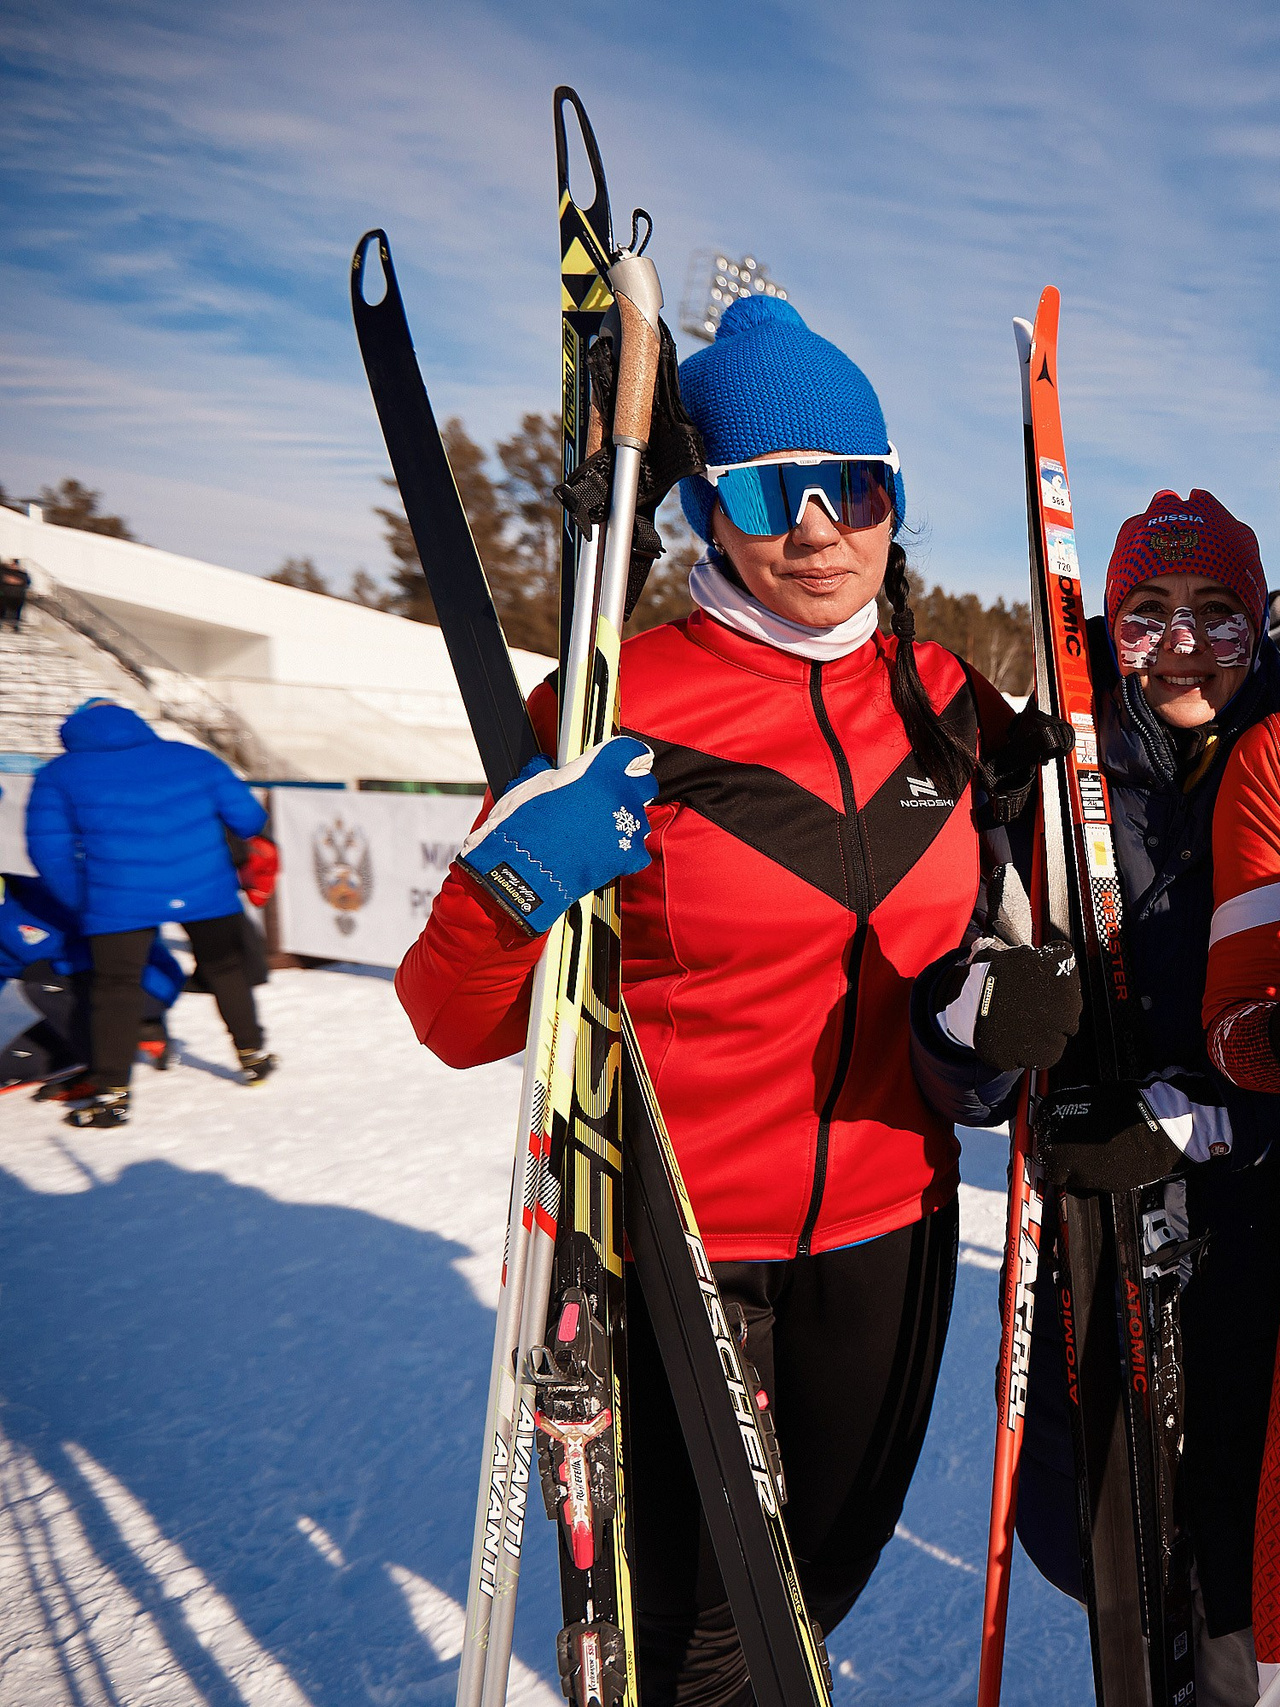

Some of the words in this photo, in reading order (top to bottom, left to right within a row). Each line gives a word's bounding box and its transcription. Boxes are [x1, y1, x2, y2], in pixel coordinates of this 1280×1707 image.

[1147, 512, 1204, 527] RUSSIA
[900, 799, 954, 808] NORDSKI
[1101, 890, 1128, 1001] REDSTER
[684, 1231, 778, 1518] FISCHER
[1061, 1288, 1079, 1406] ATOMIC
[1125, 1278, 1148, 1394] ATOMIC
[479, 1430, 510, 1599] AVANTI
[502, 1397, 536, 1560] AVANTI
[785, 1570, 804, 1616] aircore
[1172, 1680, 1194, 1707] 180
